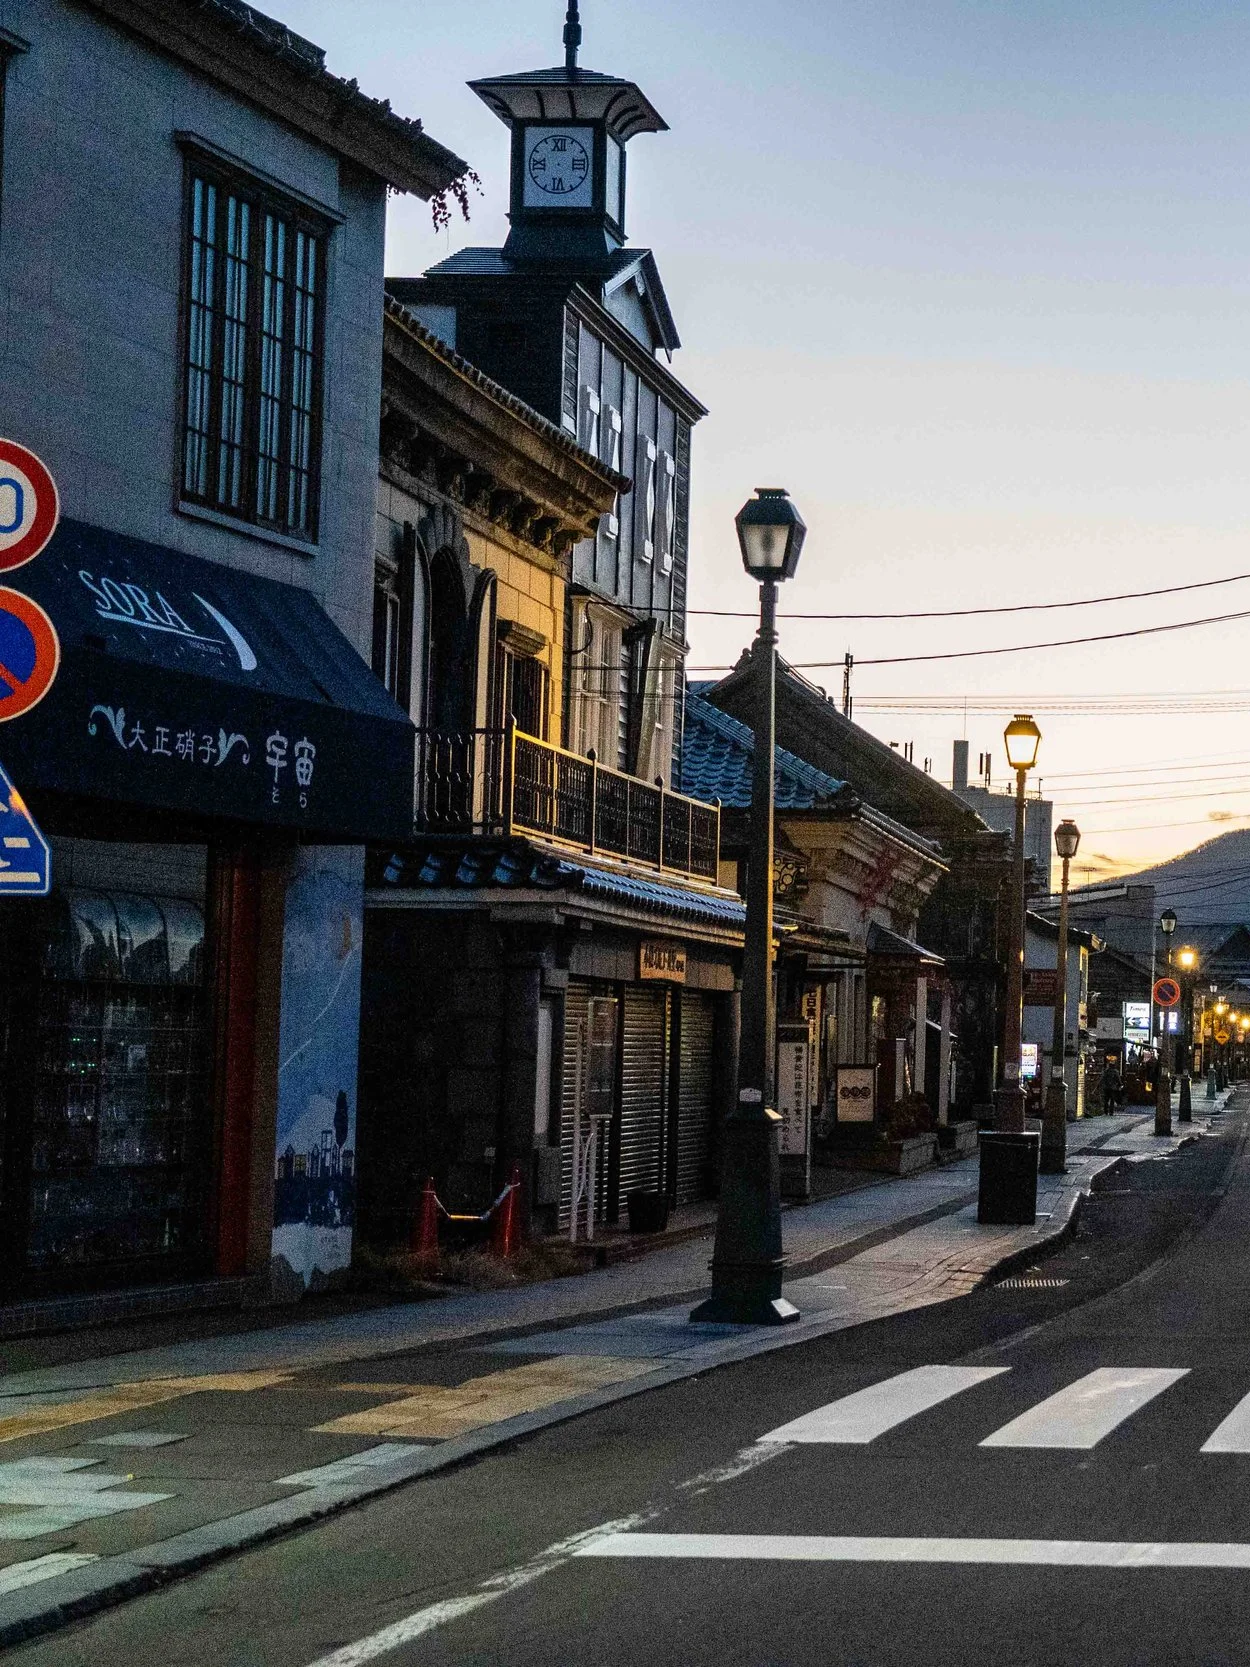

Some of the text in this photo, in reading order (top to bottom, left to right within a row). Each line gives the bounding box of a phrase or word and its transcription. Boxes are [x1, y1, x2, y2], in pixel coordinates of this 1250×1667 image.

[551, 138, 568, 152] XII
[78, 569, 196, 633] SORA
[128, 720, 317, 787] 大正硝子 宇宙
